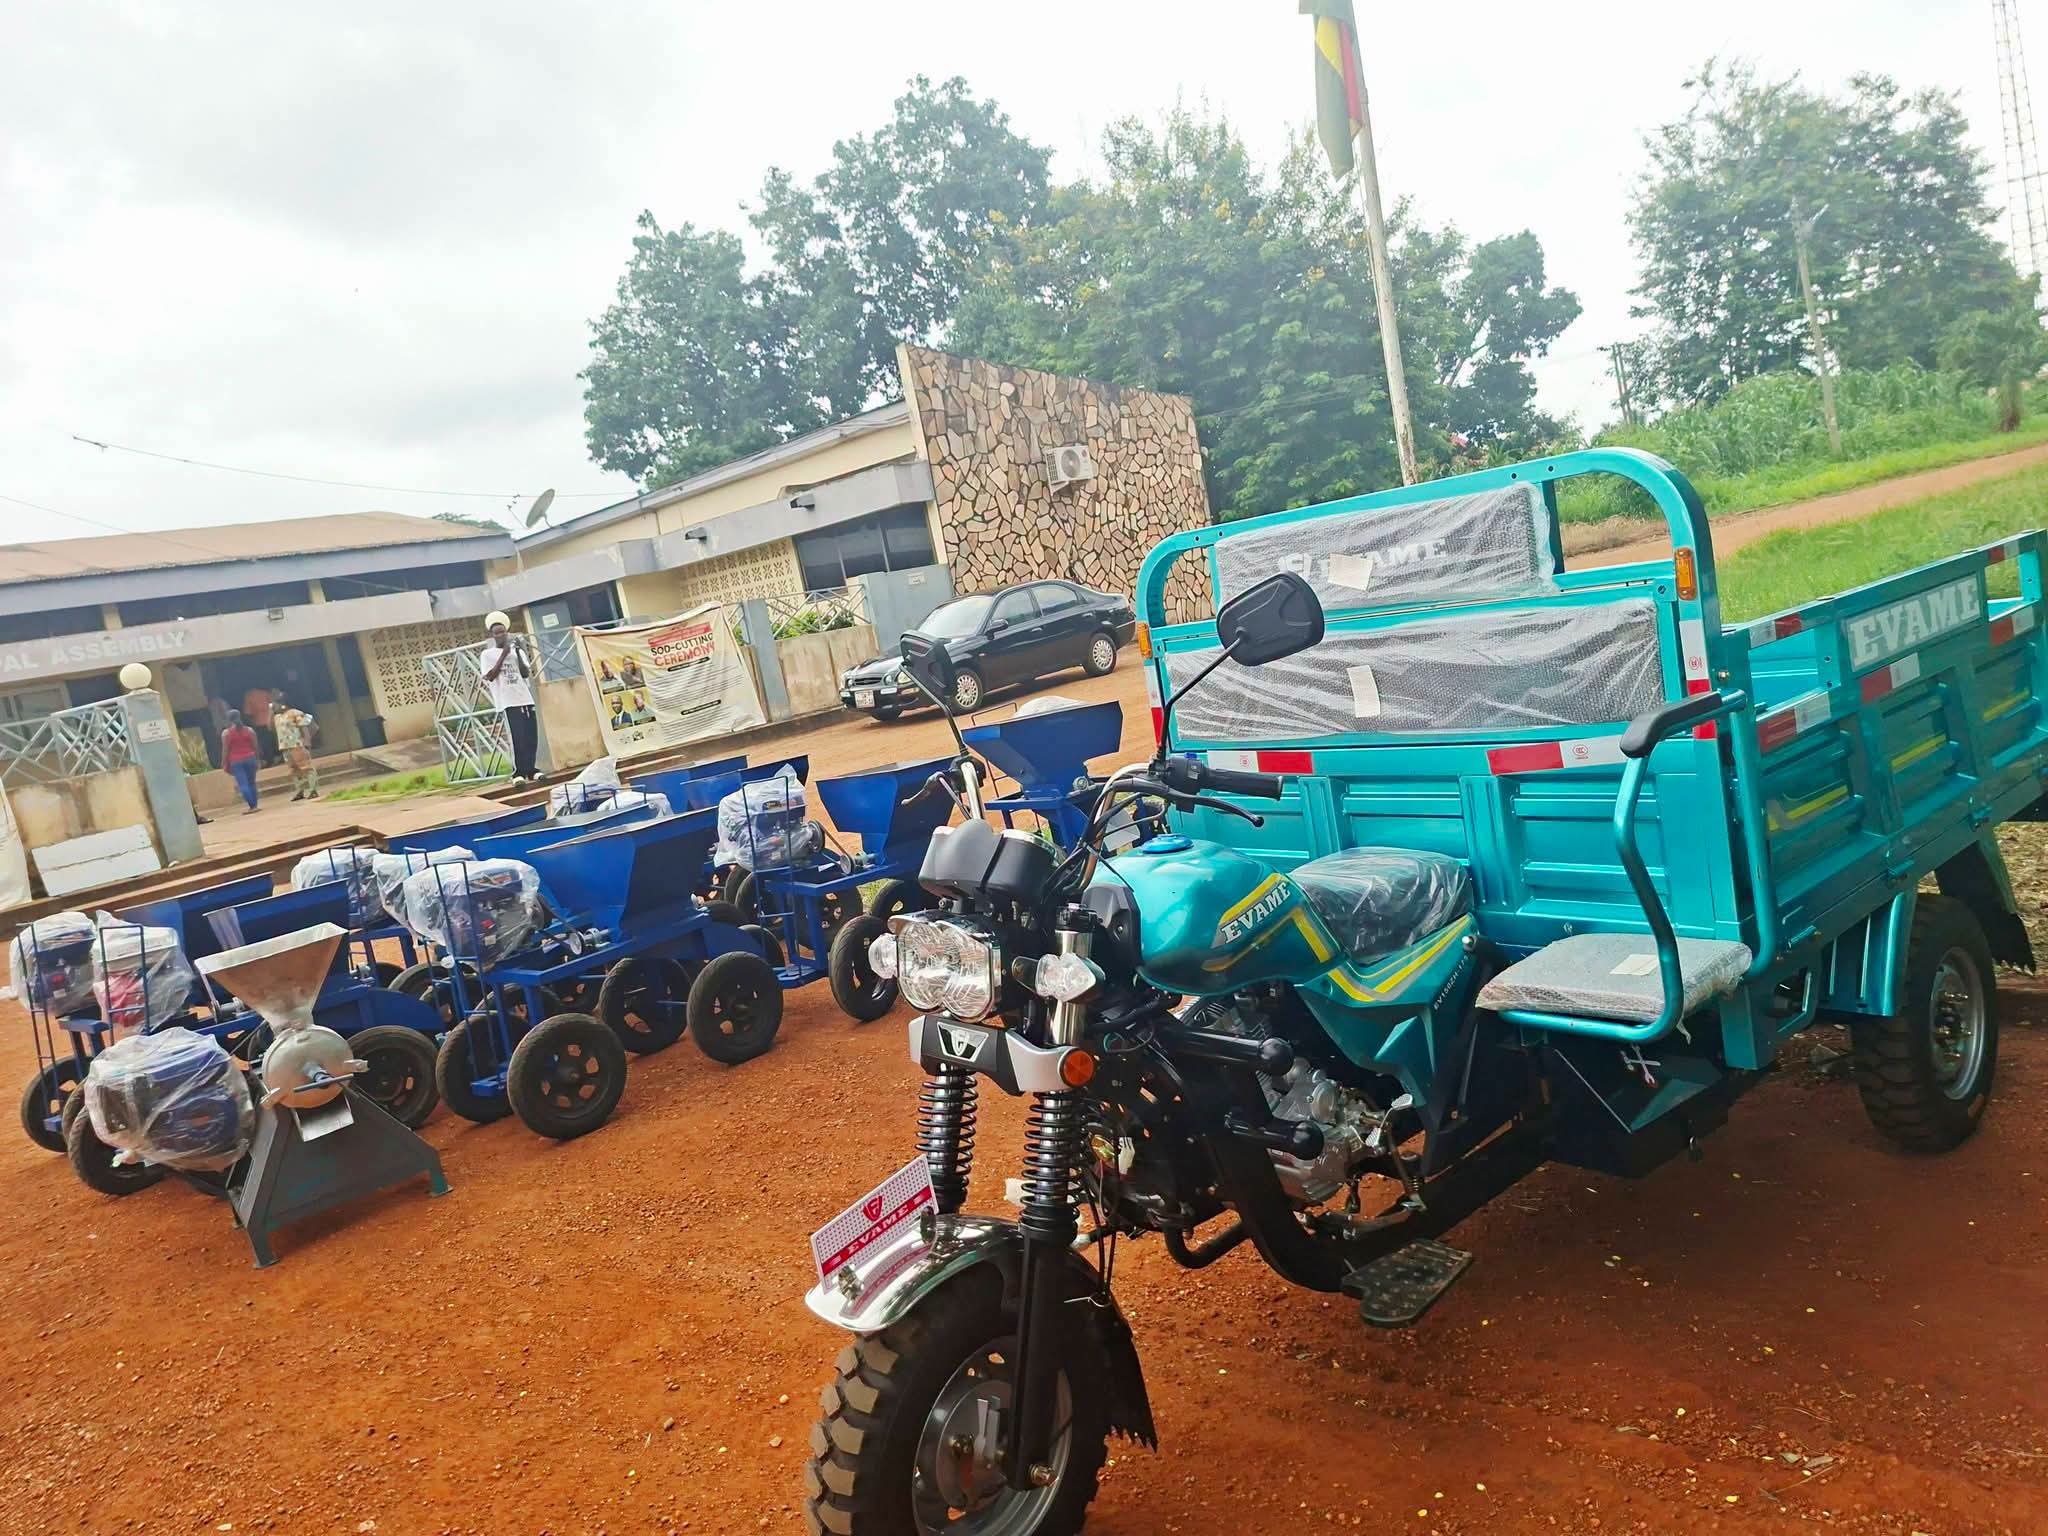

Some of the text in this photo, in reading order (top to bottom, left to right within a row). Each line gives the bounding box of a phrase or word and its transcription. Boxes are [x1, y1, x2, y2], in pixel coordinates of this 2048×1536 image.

[1850, 576, 1980, 668] EVAME
[0, 631, 185, 673] AL ASSEMBLY
[655, 641, 715, 667] CEREMONY
[1221, 882, 1291, 944] EVAME
[848, 1203, 909, 1252] EVAME
